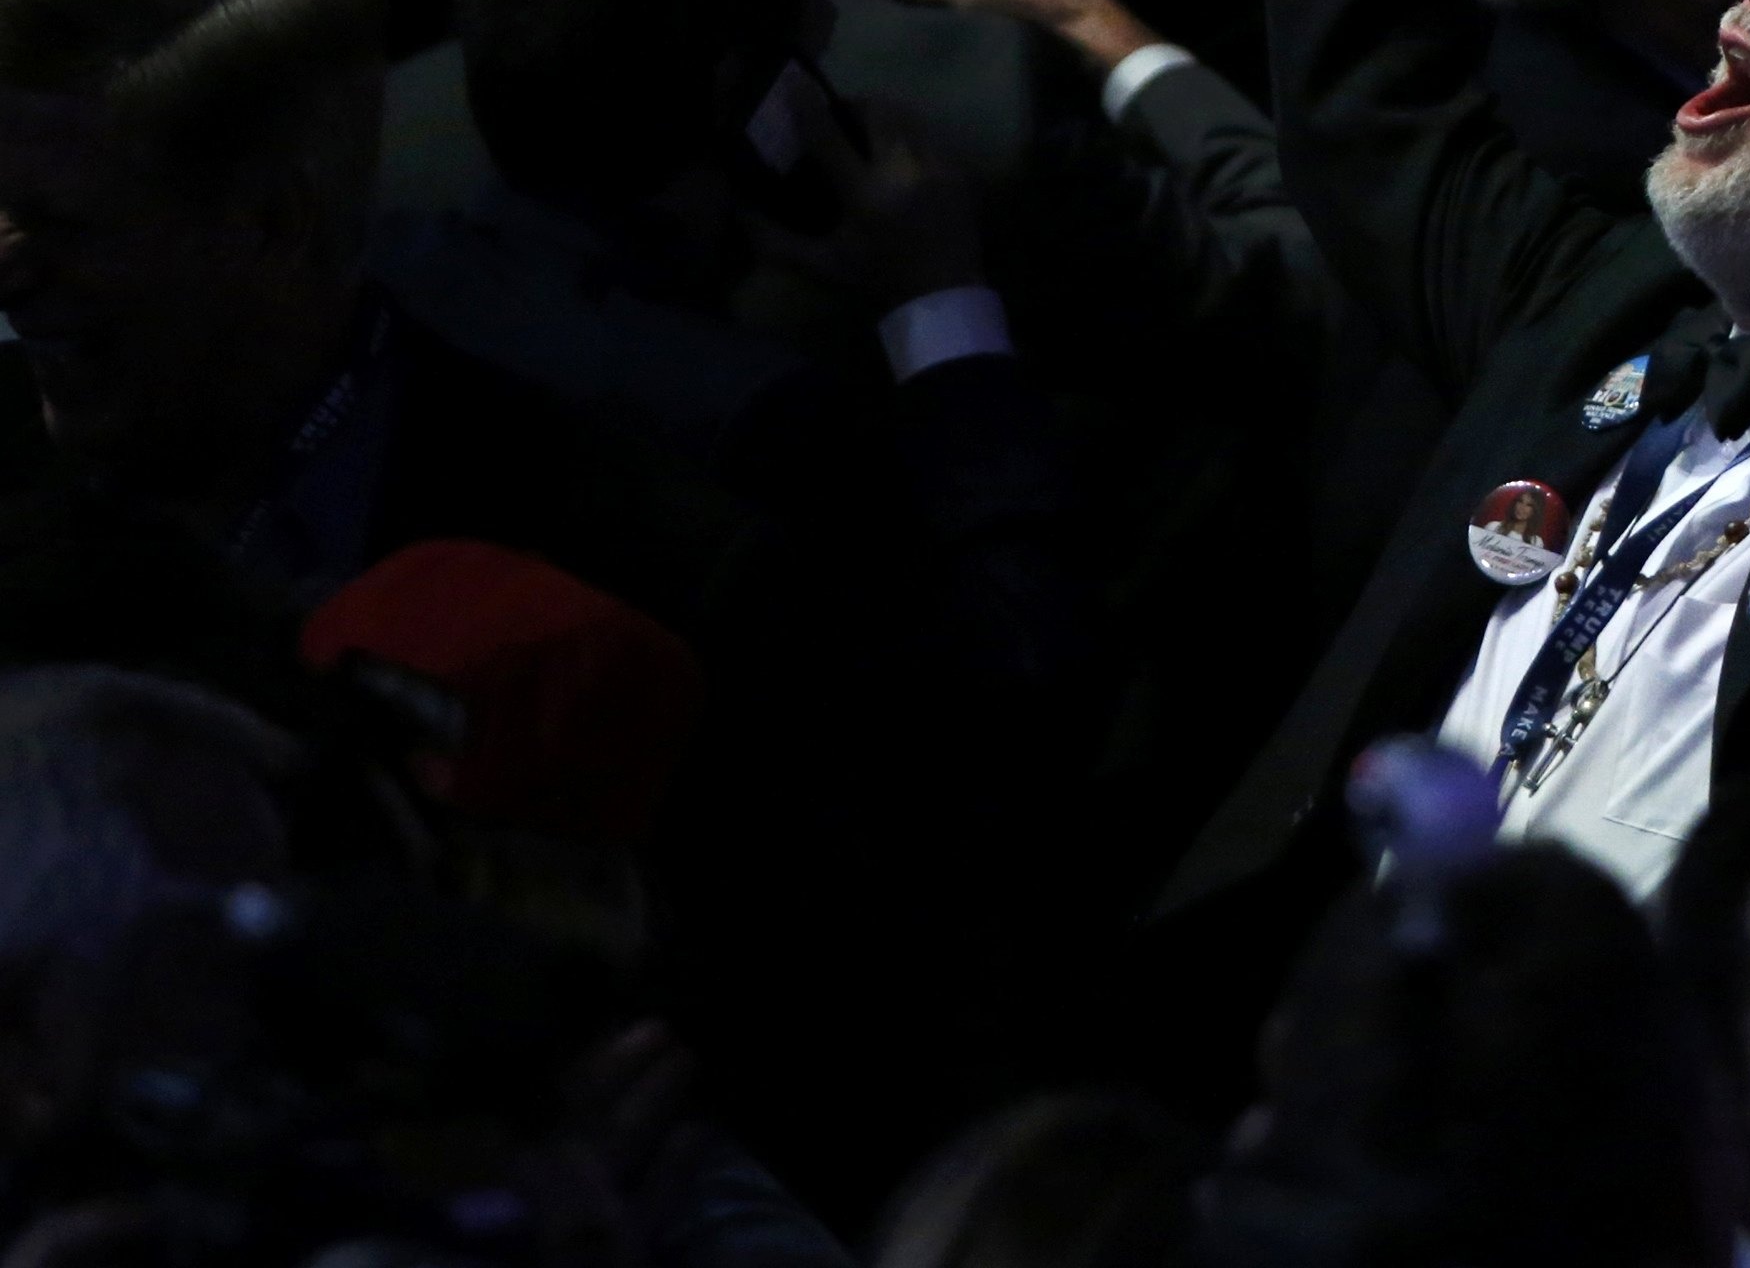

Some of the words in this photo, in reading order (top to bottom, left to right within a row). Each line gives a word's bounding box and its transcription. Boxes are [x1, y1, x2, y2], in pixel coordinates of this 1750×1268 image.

[1554, 584, 1606, 651] PENCE
[1563, 587, 1624, 663] TRUMP
[1510, 685, 1549, 741] MAKE
